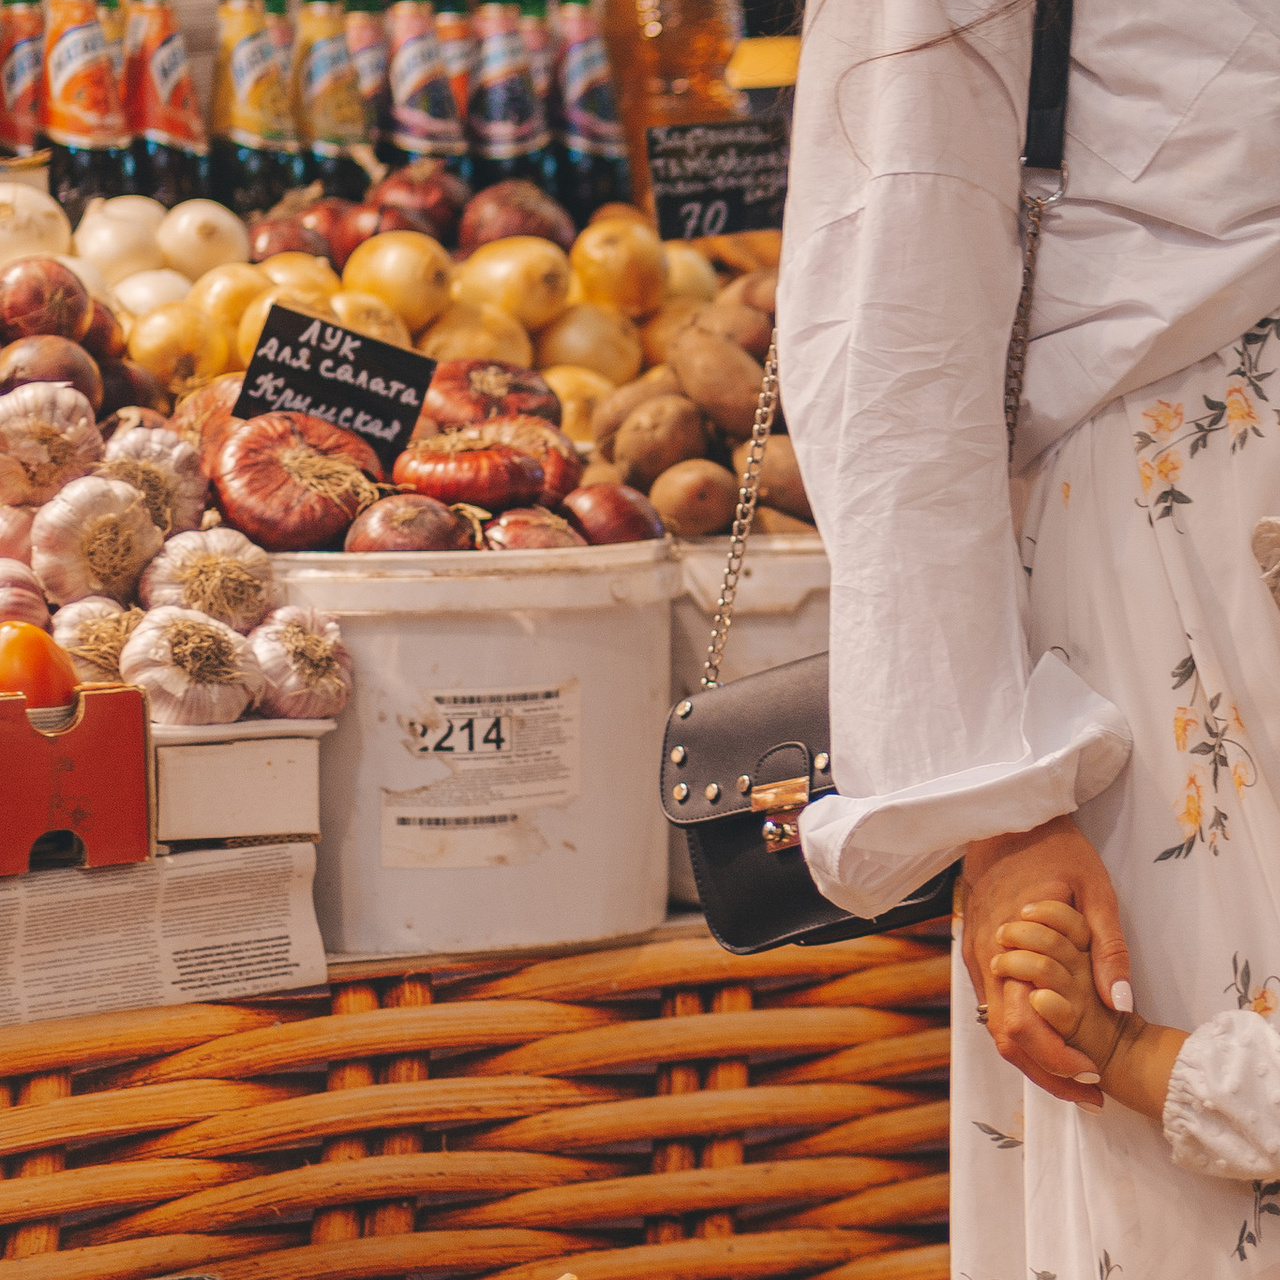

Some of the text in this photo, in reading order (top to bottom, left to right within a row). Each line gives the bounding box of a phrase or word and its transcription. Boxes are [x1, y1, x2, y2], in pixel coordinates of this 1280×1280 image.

[679, 200, 729, 241] 70
[298, 320, 362, 362] ЛУК
[318, 358, 420, 407] салата
